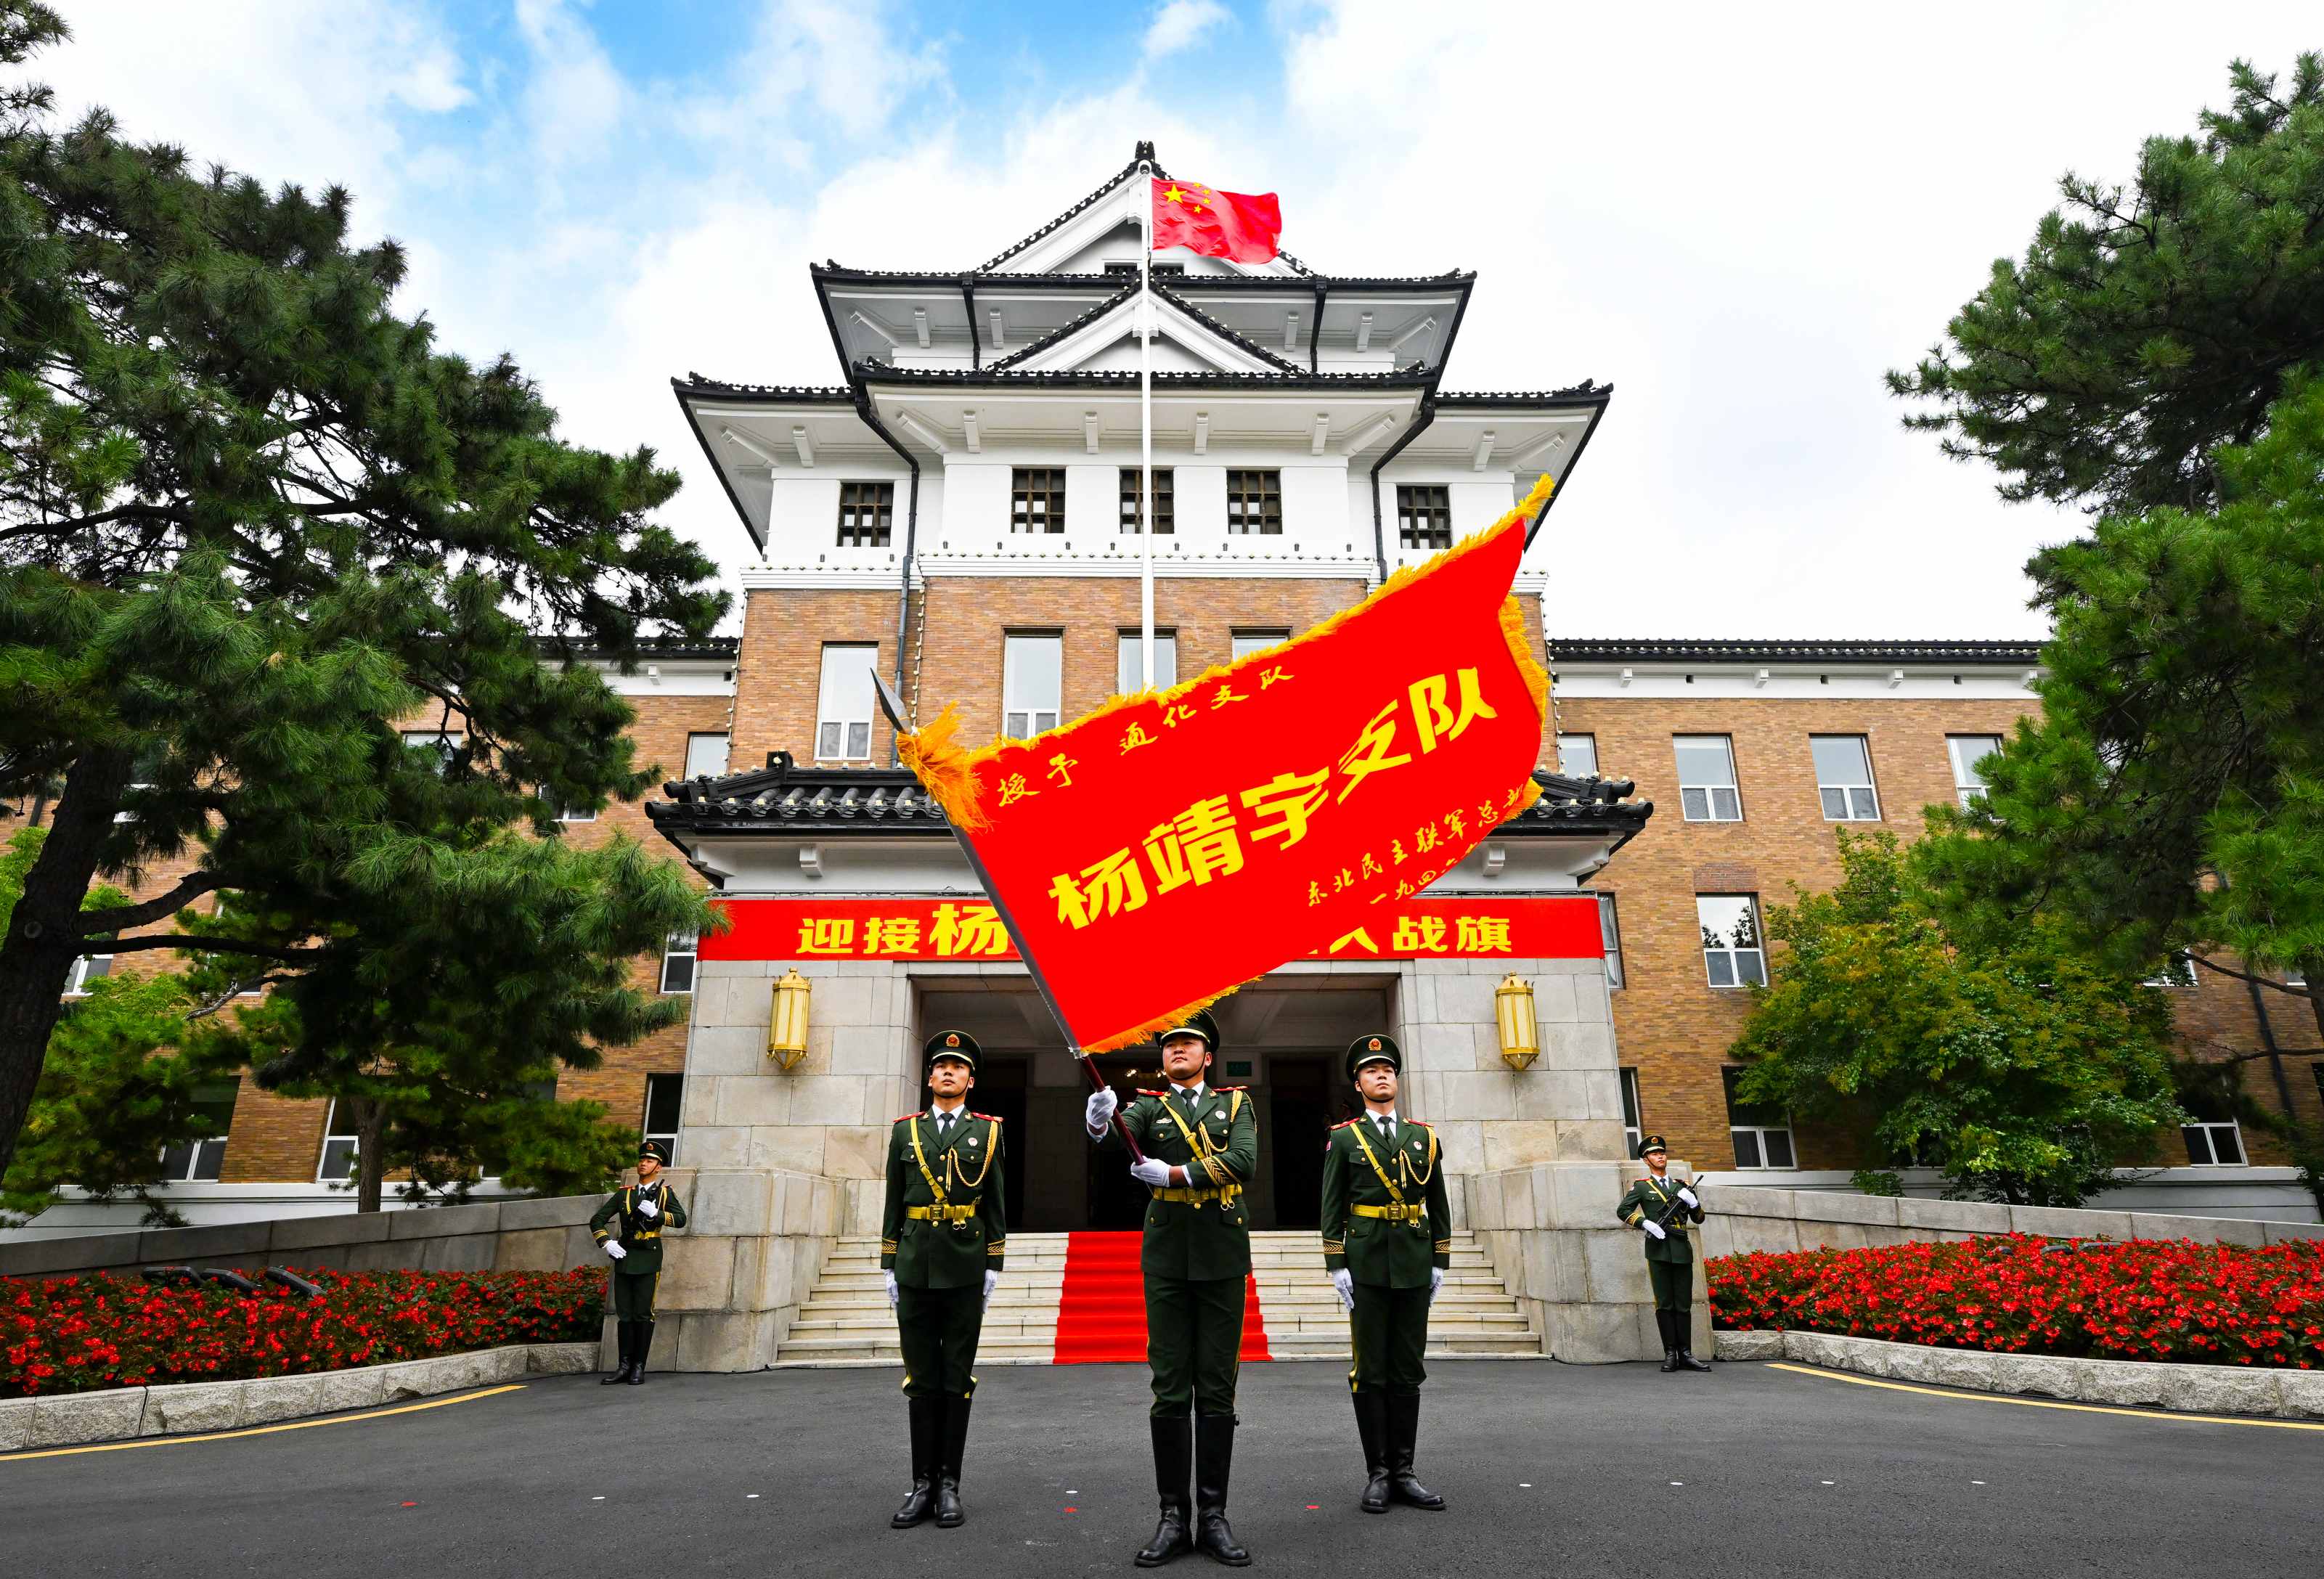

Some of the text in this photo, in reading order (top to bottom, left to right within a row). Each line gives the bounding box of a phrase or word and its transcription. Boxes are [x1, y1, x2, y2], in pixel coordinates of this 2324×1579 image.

[1048, 666, 1498, 930] 杨靖宇支队
[1120, 666, 1294, 756] 通化支队
